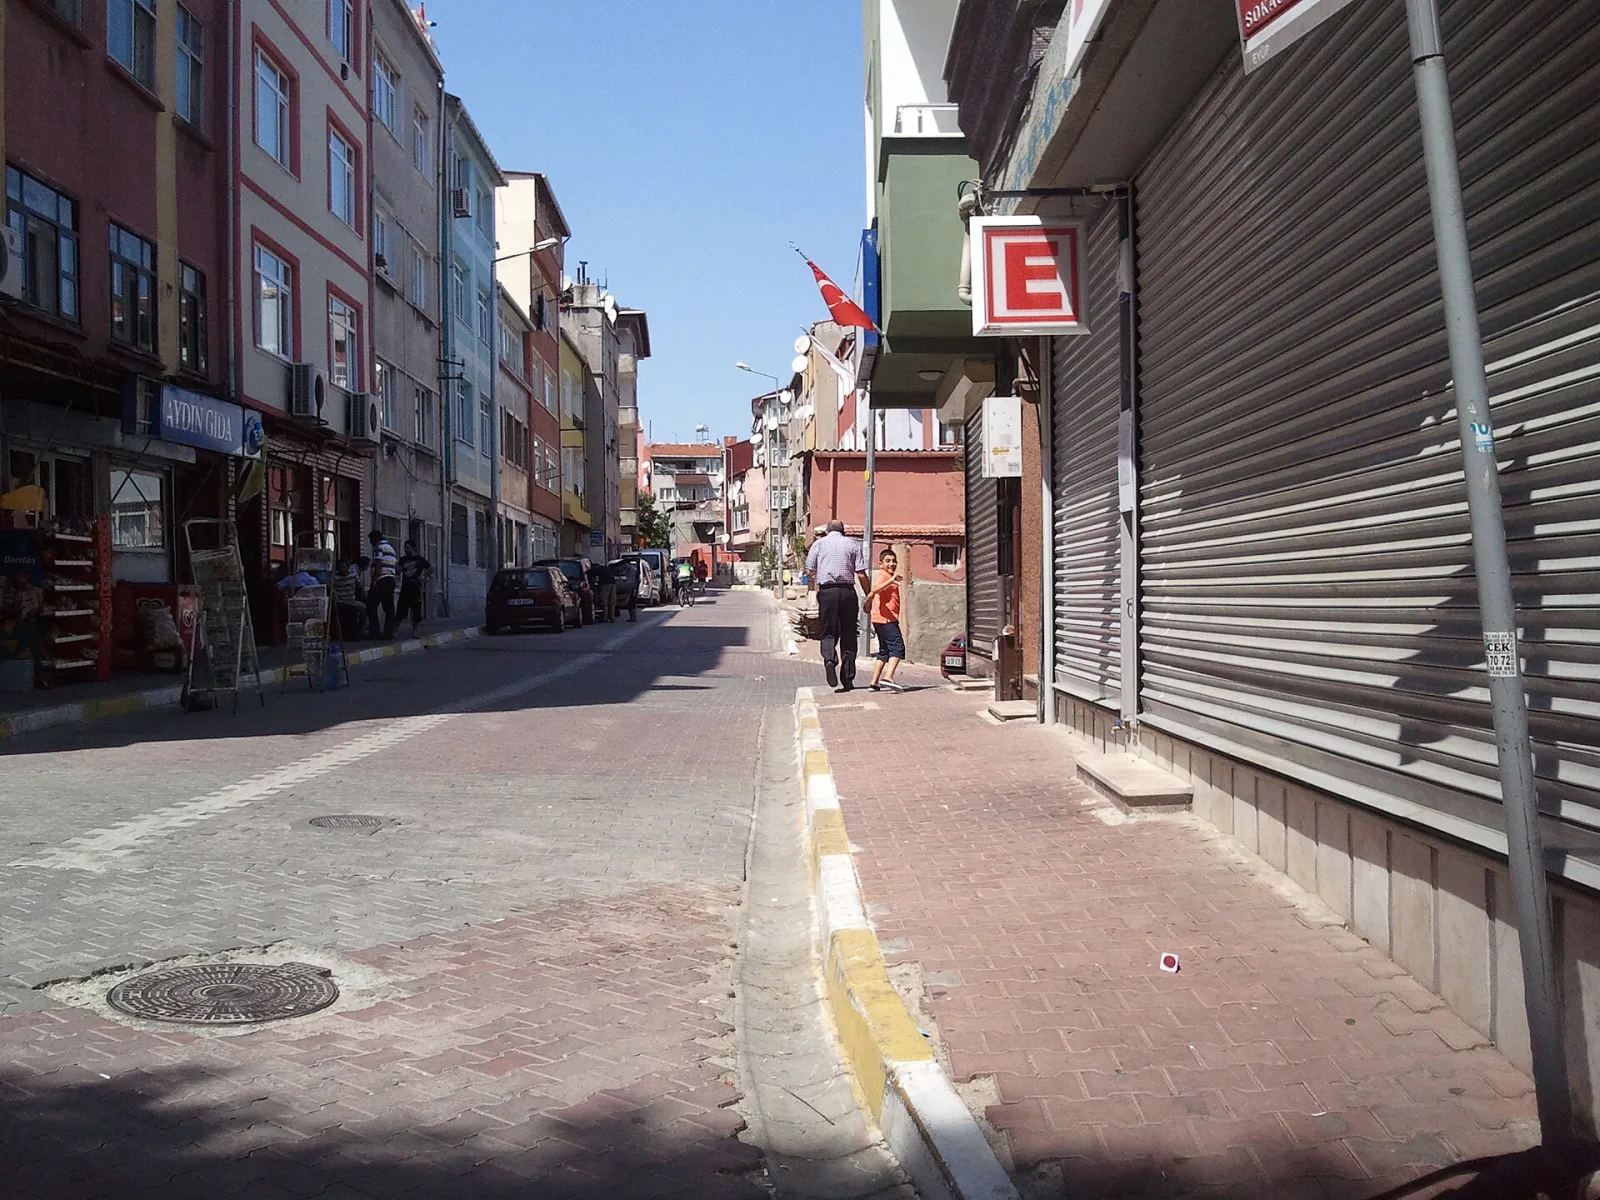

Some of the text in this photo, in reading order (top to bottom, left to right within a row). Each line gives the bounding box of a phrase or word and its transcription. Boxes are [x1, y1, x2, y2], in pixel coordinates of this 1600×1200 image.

[1251, 44, 1270, 65] EYÜP
[1004, 241, 1063, 311] E
[166, 399, 203, 434] AYDIN
[205, 409, 232, 442] GIDA
[3, 555, 37, 565] Doritos
